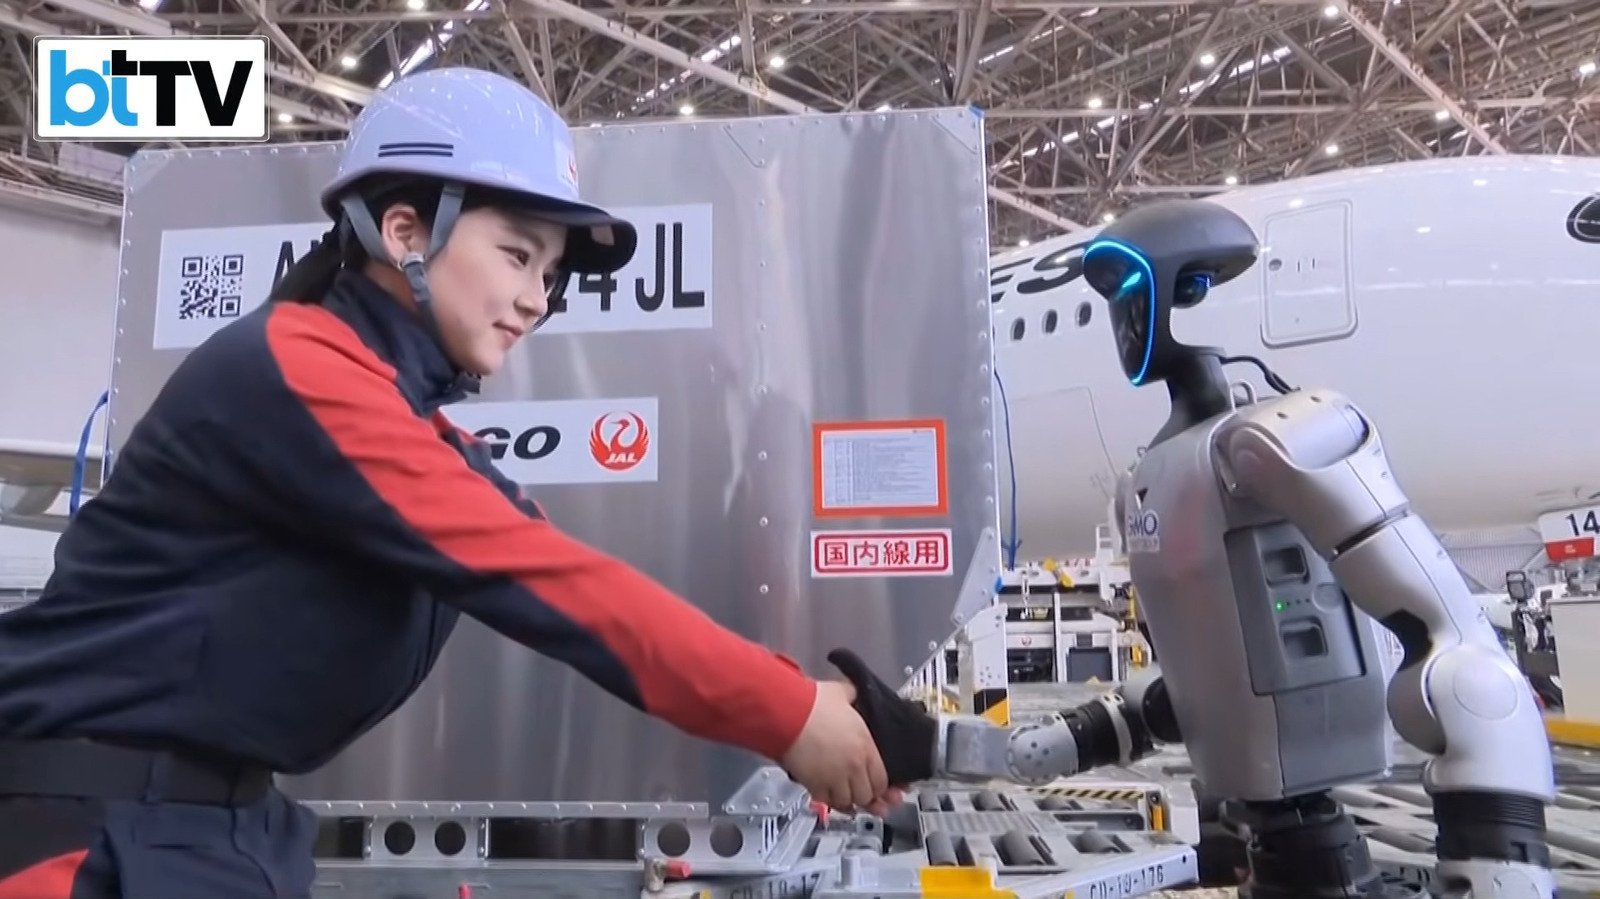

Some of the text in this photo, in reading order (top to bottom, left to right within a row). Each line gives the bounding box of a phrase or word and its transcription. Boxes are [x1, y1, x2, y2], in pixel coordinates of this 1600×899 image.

[605, 452, 637, 464] JAL
[824, 540, 939, 566] 国内線用
